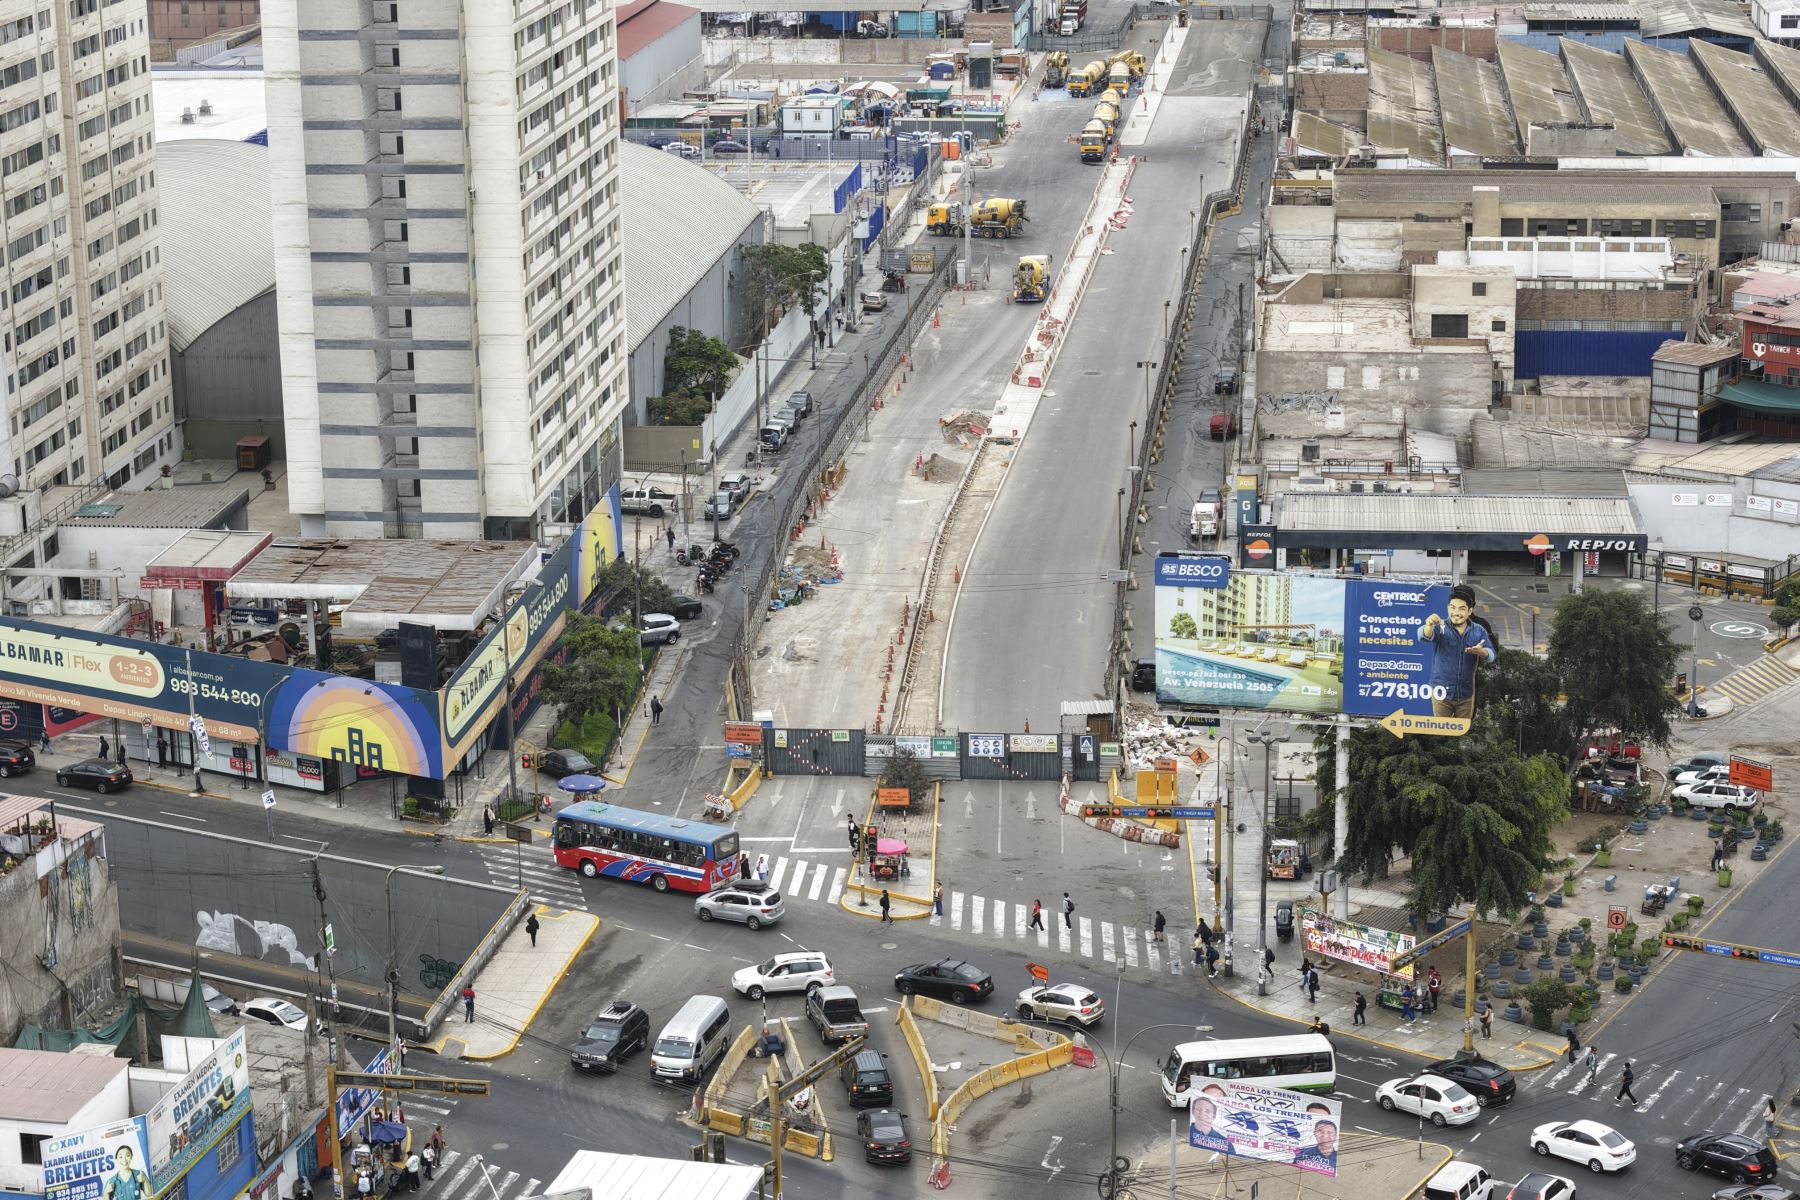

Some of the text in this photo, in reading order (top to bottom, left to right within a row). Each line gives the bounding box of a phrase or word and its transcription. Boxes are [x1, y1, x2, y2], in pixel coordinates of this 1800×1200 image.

[1567, 539, 1637, 551] REPSOL
[1179, 564, 1223, 577] BESCO
[555, 572, 569, 603] 800
[1359, 614, 1422, 626] Conectado
[1359, 625, 1407, 637] a lo que
[1359, 636, 1414, 646] necesitas
[73, 655, 102, 673] Flex
[1359, 660, 1388, 670] Depas
[1397, 660, 1422, 670] dorm
[1366, 671, 1409, 680] ambiente
[461, 659, 494, 708] ALBAMAR
[1163, 677, 1181, 686] Av.
[1184, 678, 1244, 690] Venezuela
[1246, 681, 1274, 692] 2505
[58, 694, 81, 707] Verde
[201, 683, 230, 702] 544
[231, 689, 261, 707] 800
[2, 713, 12, 726] E
[1390, 719, 1464, 731] a 10 minutos
[1403, 939, 1413, 950] 18
[172, 1065, 223, 1124] BREVETES
[173, 1077, 196, 1102] EXAMEN
[1229, 1083, 1302, 1101] MARCA LOS TRENES
[1216, 1098, 1313, 1121] MARCA LOS TRENES
[60, 1135, 85, 1149] XAVY
[44, 1153, 75, 1168] EXAMEN
[44, 1154, 115, 1185] BREVETES
